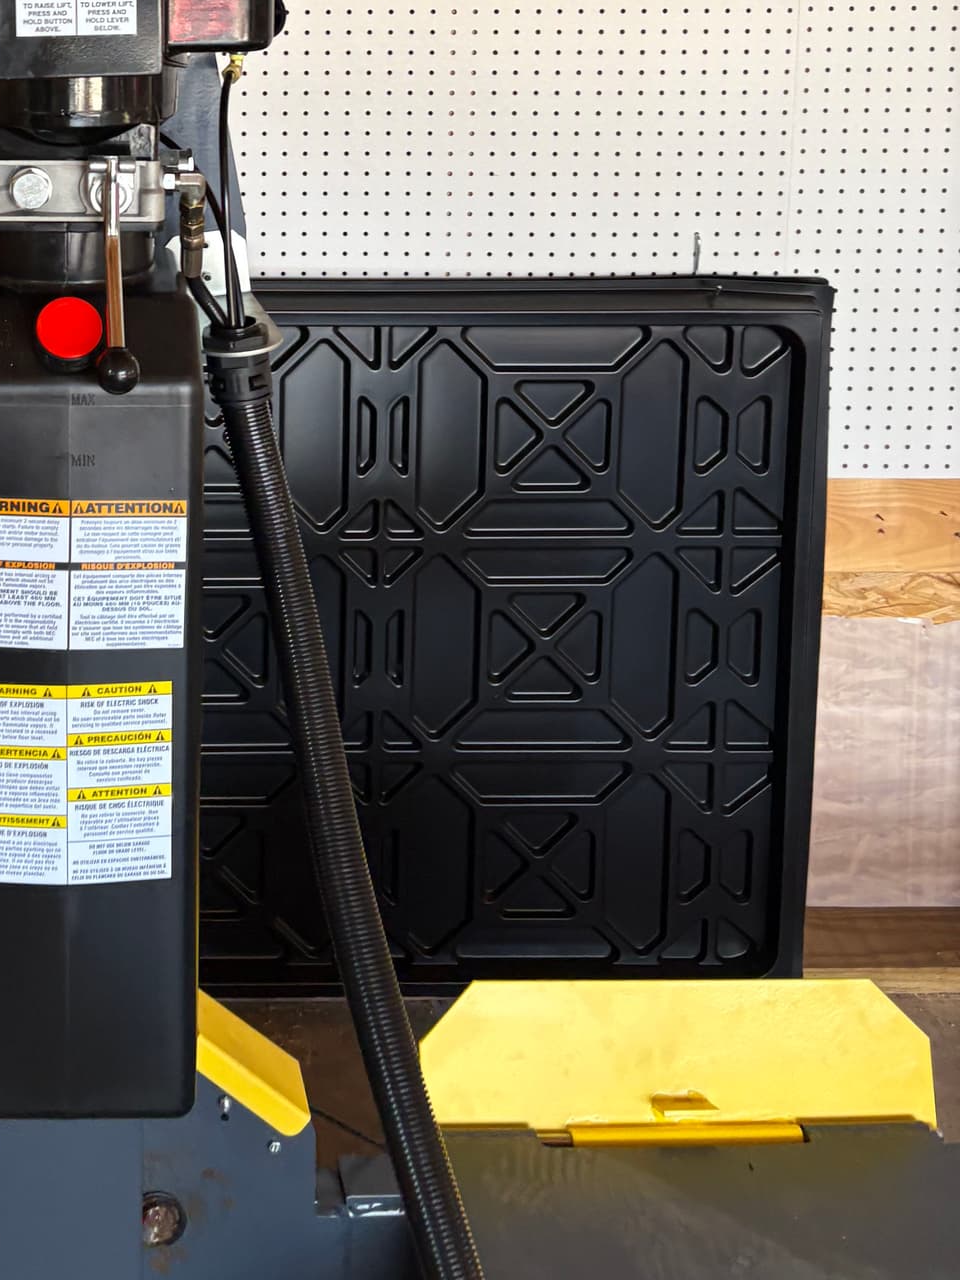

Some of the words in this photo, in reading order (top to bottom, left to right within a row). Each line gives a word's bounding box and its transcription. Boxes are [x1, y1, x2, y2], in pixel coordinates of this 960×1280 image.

[71, 393, 96, 406] MAX
[71, 454, 96, 467] MIN
[86, 503, 173, 514] ATTENTION
[5, 561, 55, 569] EXPLOSION
[81, 562, 114, 570] RISQUE
[116, 562, 175, 570] D'EXPLOSION
[97, 685, 142, 694] CAUTION
[87, 732, 151, 743] PRECAUCIÓN
[92, 787, 147, 798] ATTENTION
